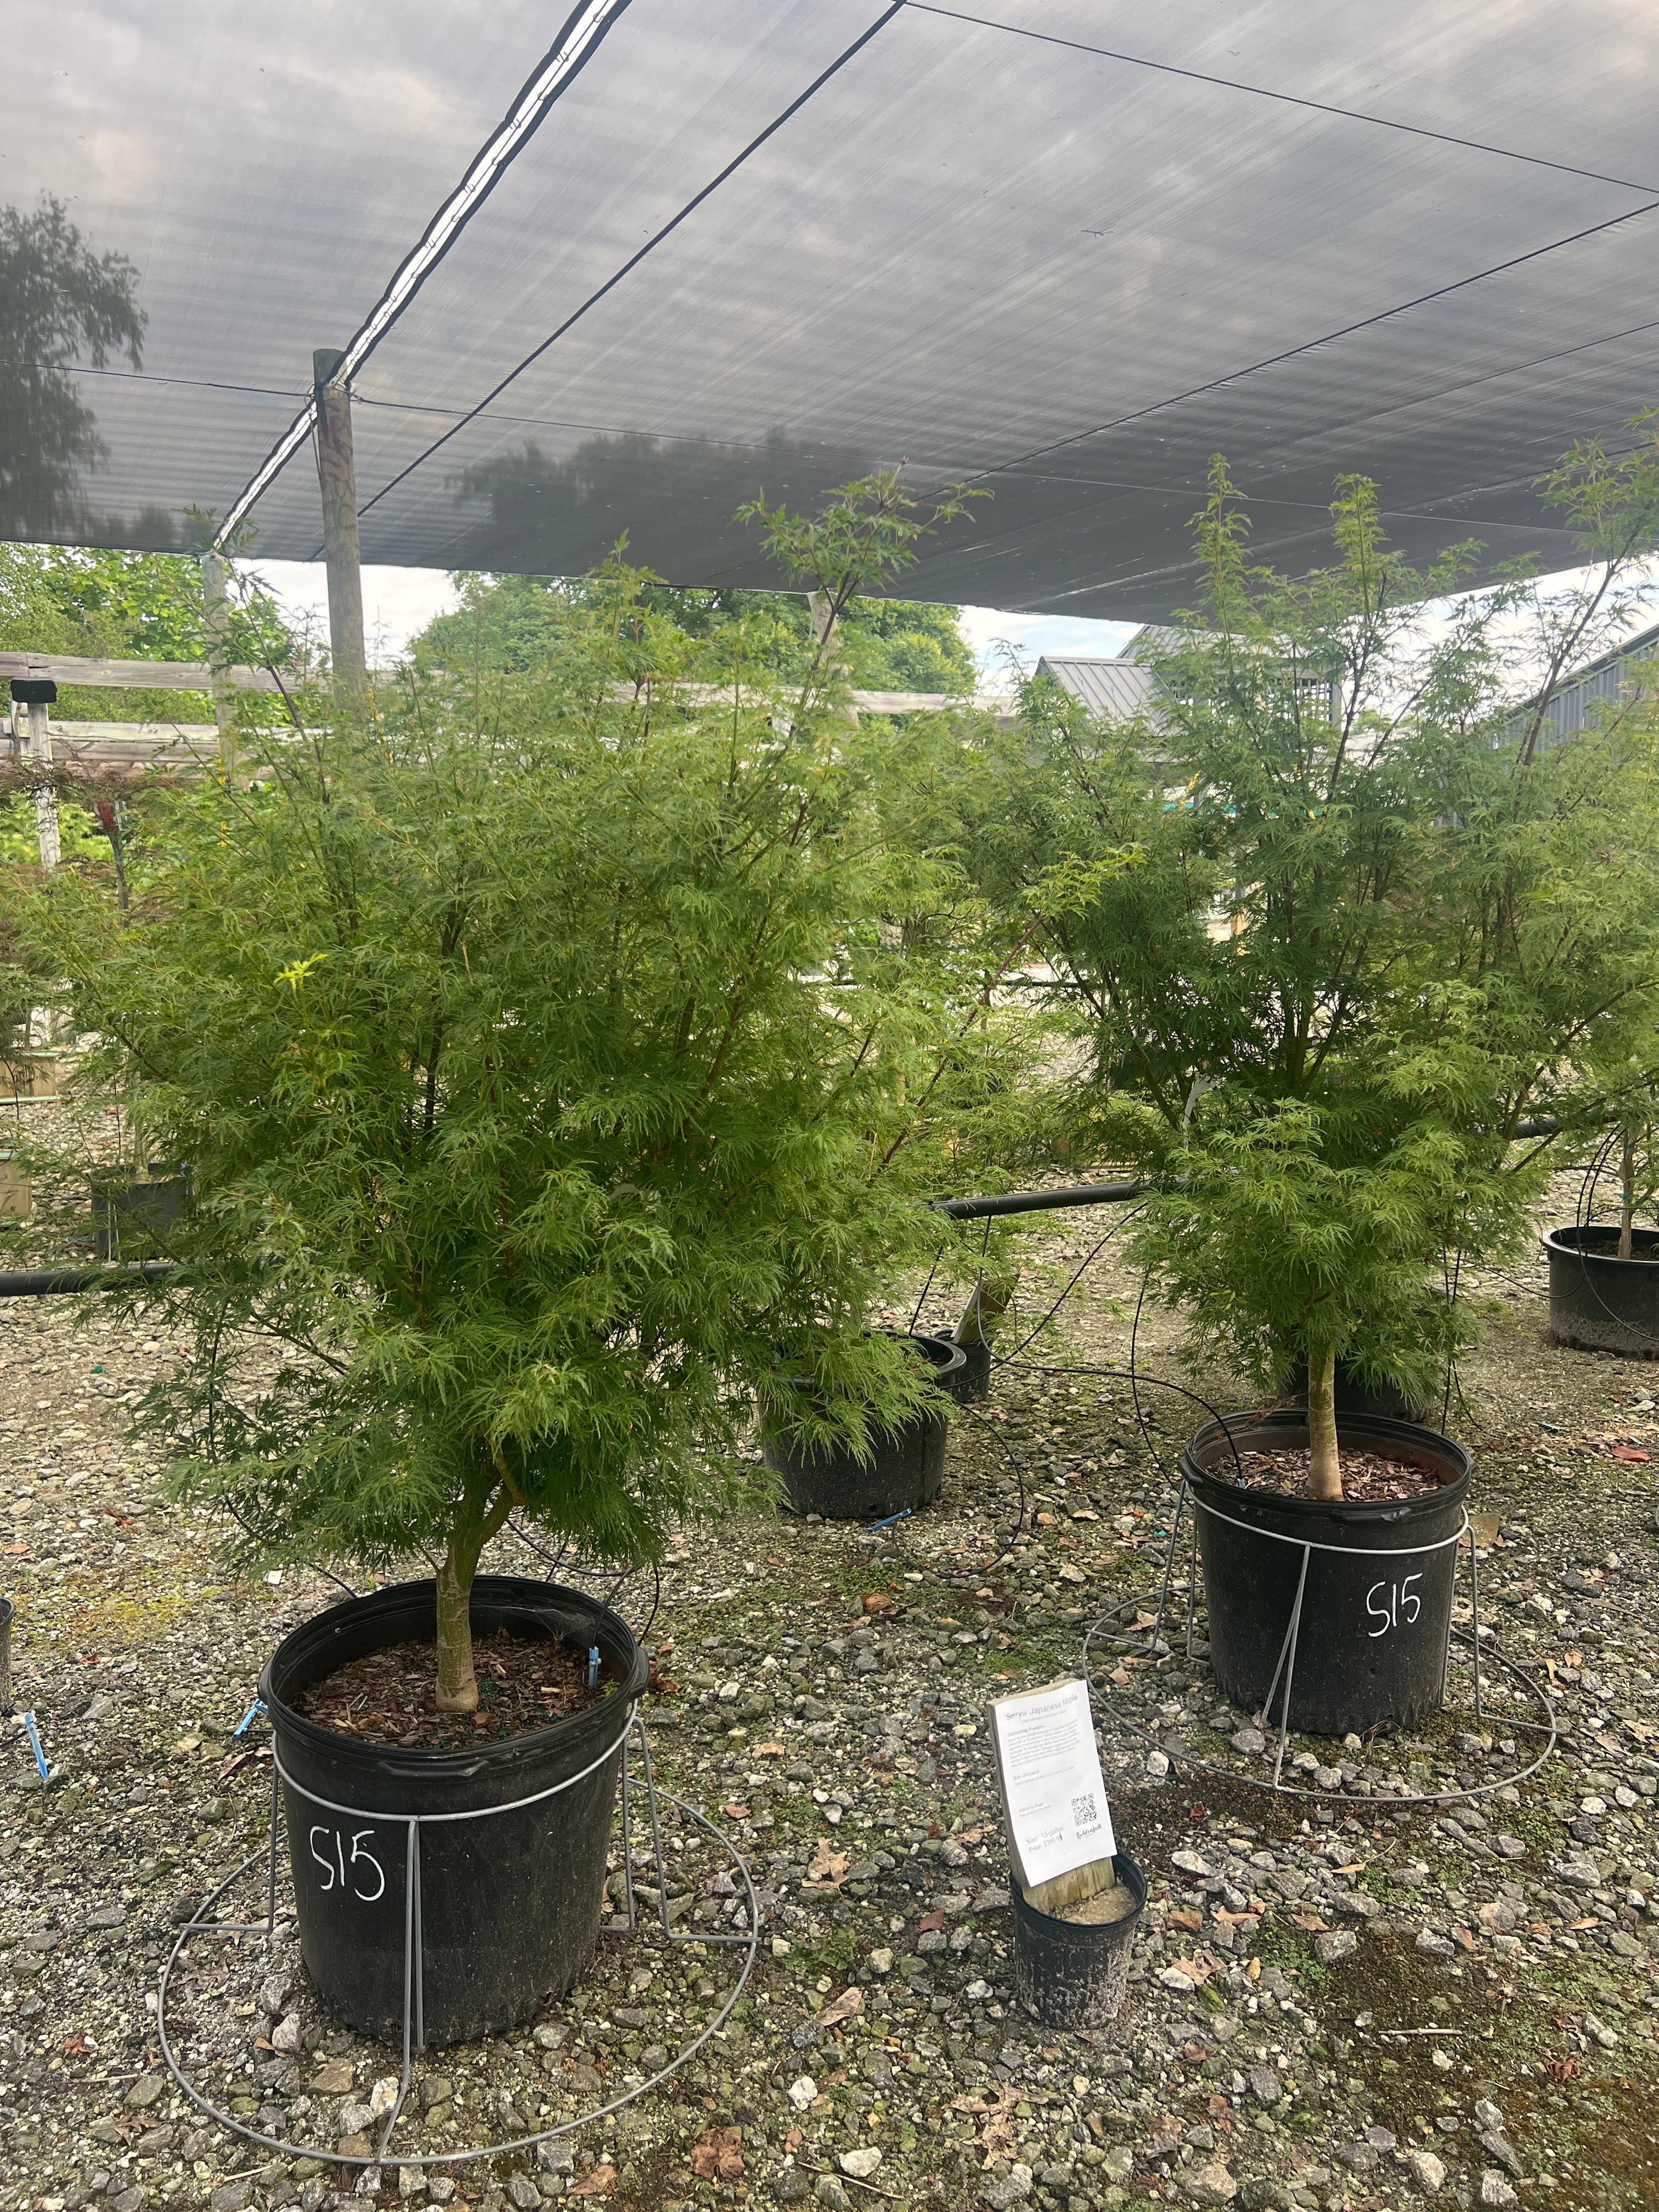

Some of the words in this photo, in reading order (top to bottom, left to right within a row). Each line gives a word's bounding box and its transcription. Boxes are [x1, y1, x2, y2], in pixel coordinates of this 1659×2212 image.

[1367, 1573, 1423, 1637] S15
[1029, 1702, 1062, 1715] Japanese
[1062, 1694, 1078, 1706] Maple
[310, 1826, 385, 1901] S15
